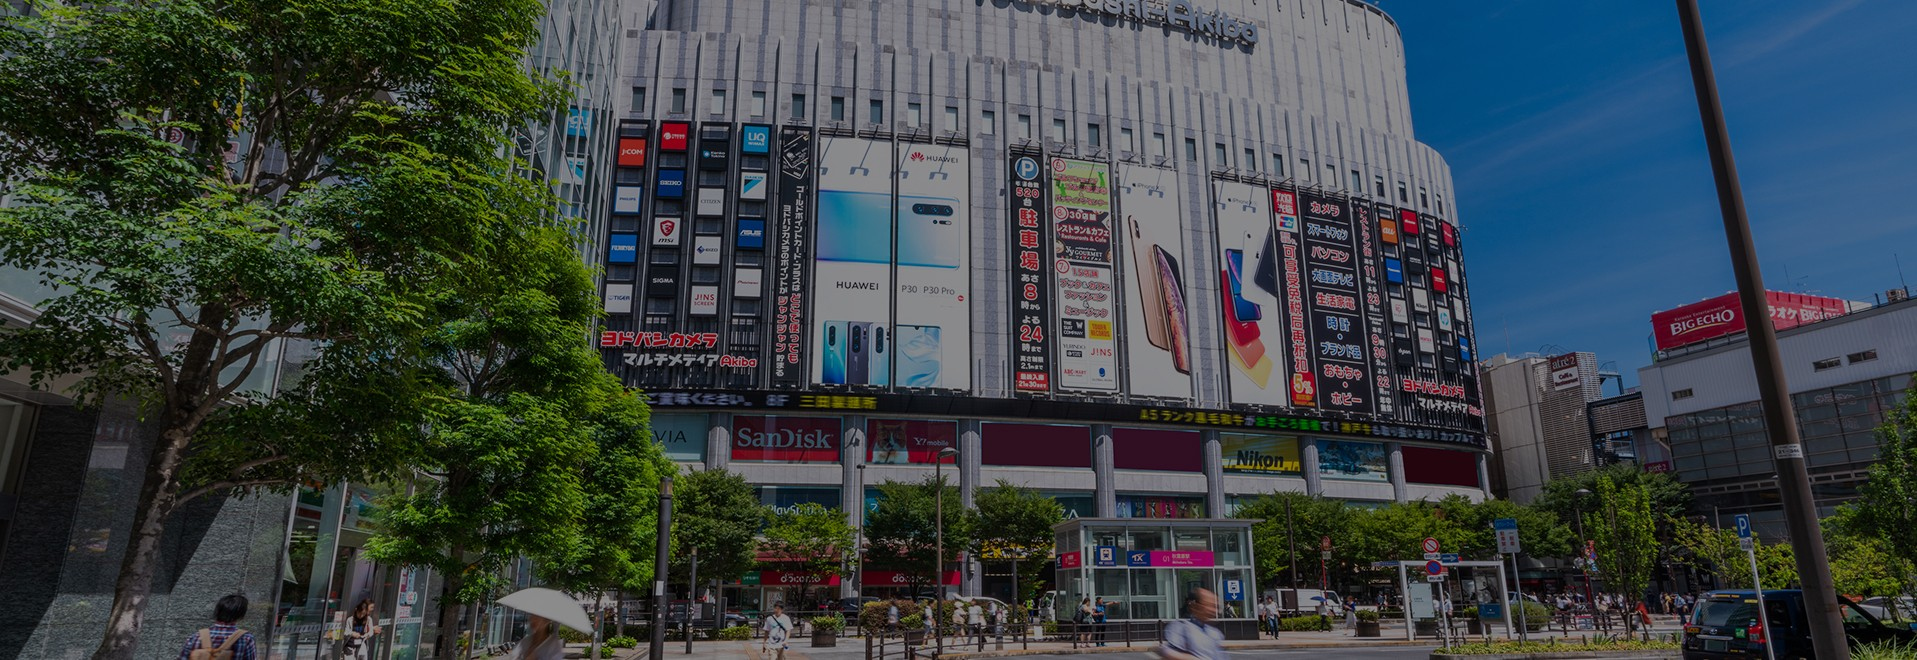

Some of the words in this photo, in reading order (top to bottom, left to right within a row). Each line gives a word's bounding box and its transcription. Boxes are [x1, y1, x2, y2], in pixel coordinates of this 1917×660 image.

[926, 156, 958, 164] HUAWEI
[1022, 160, 1034, 176] P
[1016, 186, 1040, 199] 520
[1310, 201, 1340, 217] カメラ
[1018, 208, 1040, 271] 駐車場
[1311, 246, 1350, 263] パソコン
[1021, 274, 1039, 283] あさ
[1364, 265, 1376, 277] 11
[836, 281, 879, 290] HUAWEI
[902, 285, 917, 293] P30
[923, 286, 938, 294] P30
[941, 287, 955, 296] Pro
[1024, 283, 1038, 300] 8
[1367, 293, 1380, 305] 23
[1326, 316, 1350, 332] 時計
[1670, 319, 1695, 336] BIG
[1696, 309, 1735, 326] ECHO
[600, 331, 718, 348] ヨドバシカメラ
[1020, 324, 1043, 343] 24
[1320, 341, 1362, 360] ブランド品
[1373, 346, 1386, 359] 30
[623, 353, 720, 367] マルチメディア
[720, 354, 758, 368] Akiba
[1323, 364, 1362, 381] おもちゃ
[1377, 375, 1390, 388] 22
[1403, 379, 1464, 399] ヨドバシカメラ
[1331, 392, 1362, 406] ホビー
[1418, 398, 1468, 414] マルチメディア
[737, 428, 832, 449] SanDisk
[1237, 450, 1284, 468] Nikon
[1738, 518, 1747, 535] P
